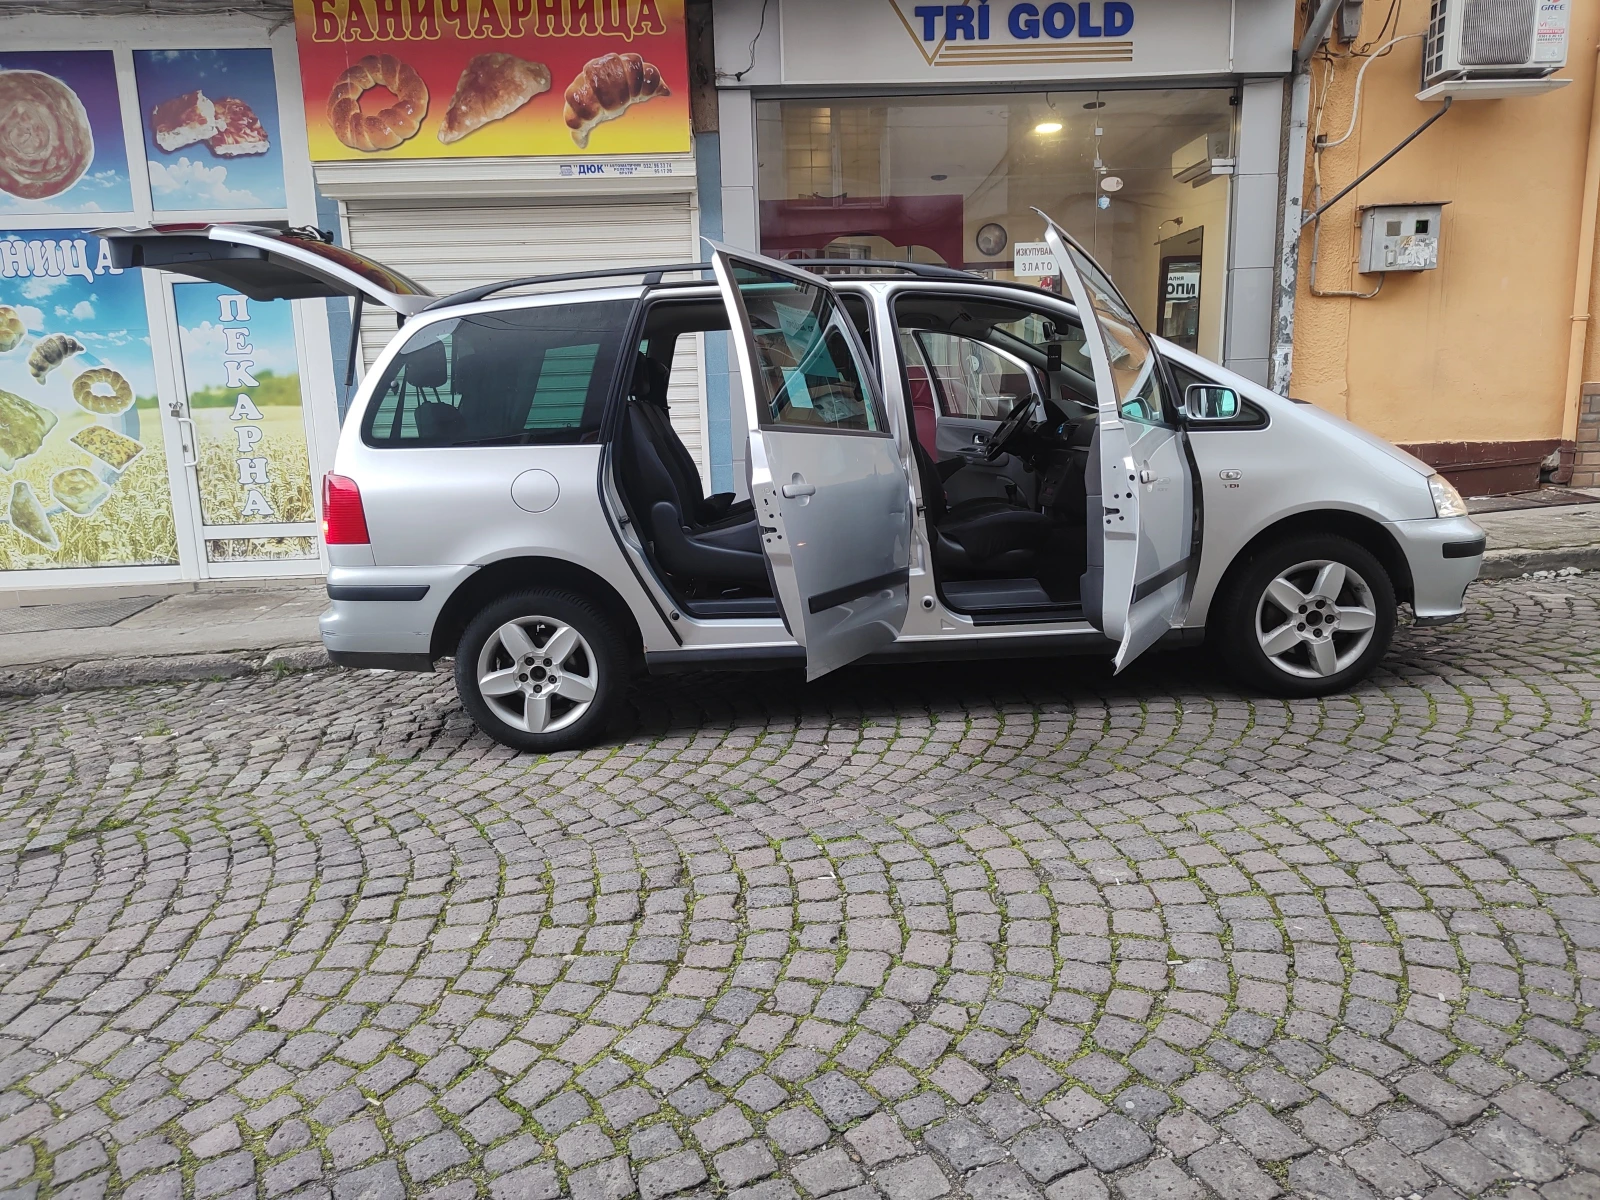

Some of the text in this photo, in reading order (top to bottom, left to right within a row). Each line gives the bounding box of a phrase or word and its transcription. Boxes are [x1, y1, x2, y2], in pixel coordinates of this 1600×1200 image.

[311, 0, 667, 42] БАНИЧАРНИЦА
[1007, 1, 1135, 40] GOLD
[1022, 261, 1052, 271] ЗЛАТО
[217, 294, 275, 516] ПЕКАРНА
